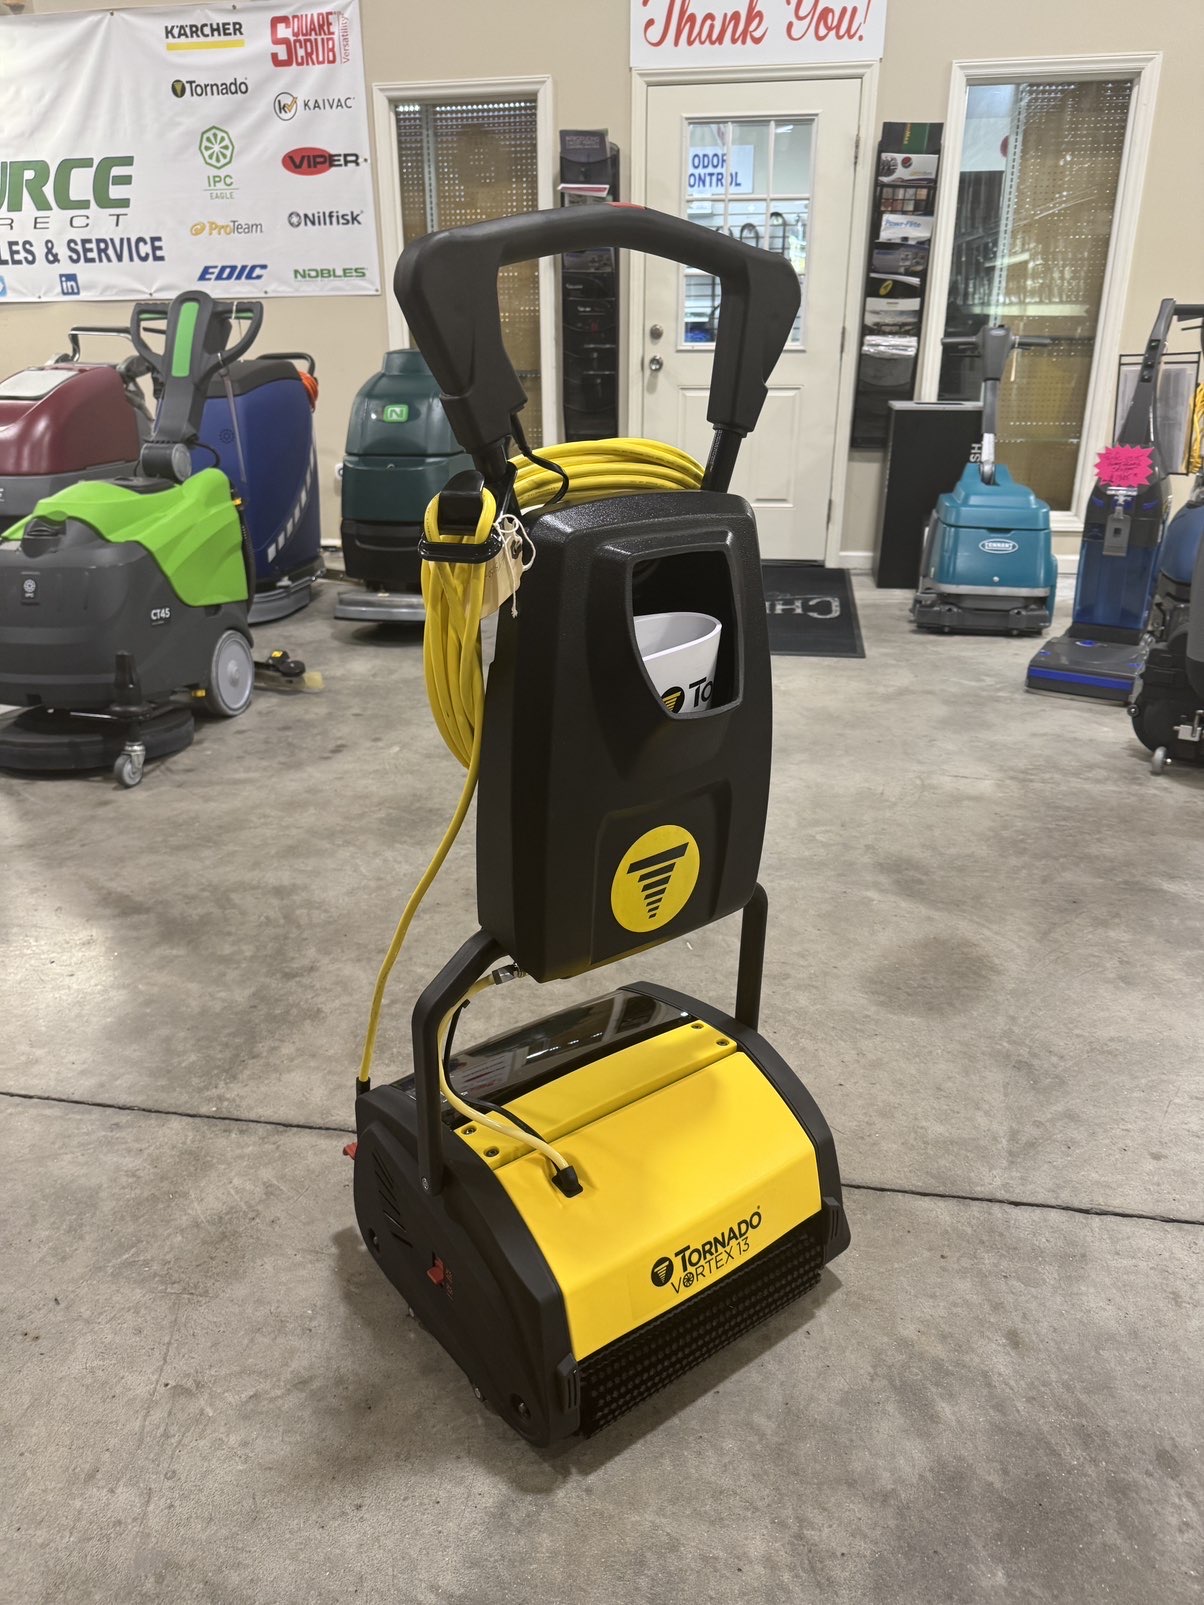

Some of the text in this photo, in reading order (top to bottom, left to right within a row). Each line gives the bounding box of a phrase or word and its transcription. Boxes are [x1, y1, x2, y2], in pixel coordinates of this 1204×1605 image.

[165, 21, 243, 39] KÄRCHER
[642, 0, 872, 47] Thank You!
[186, 78, 249, 97] Tornado
[303, 97, 353, 111] KAIVAC
[288, 153, 360, 169] VIPER
[0, 156, 134, 213] RCE
[207, 175, 234, 188] IPC
[209, 191, 235, 201] EAGLE
[208, 220, 264, 236] ProTeam
[303, 211, 362, 228] Nilfisk
[45, 239, 60, 265] &
[68, 236, 166, 263] SERVICE
[197, 264, 268, 282] EDIC
[294, 267, 367, 281] NOBLES
[151, 607, 171, 620] CT45
[674, 1210, 762, 1273] TORNADO
[671, 1236, 750, 1294] VORTEX 13
